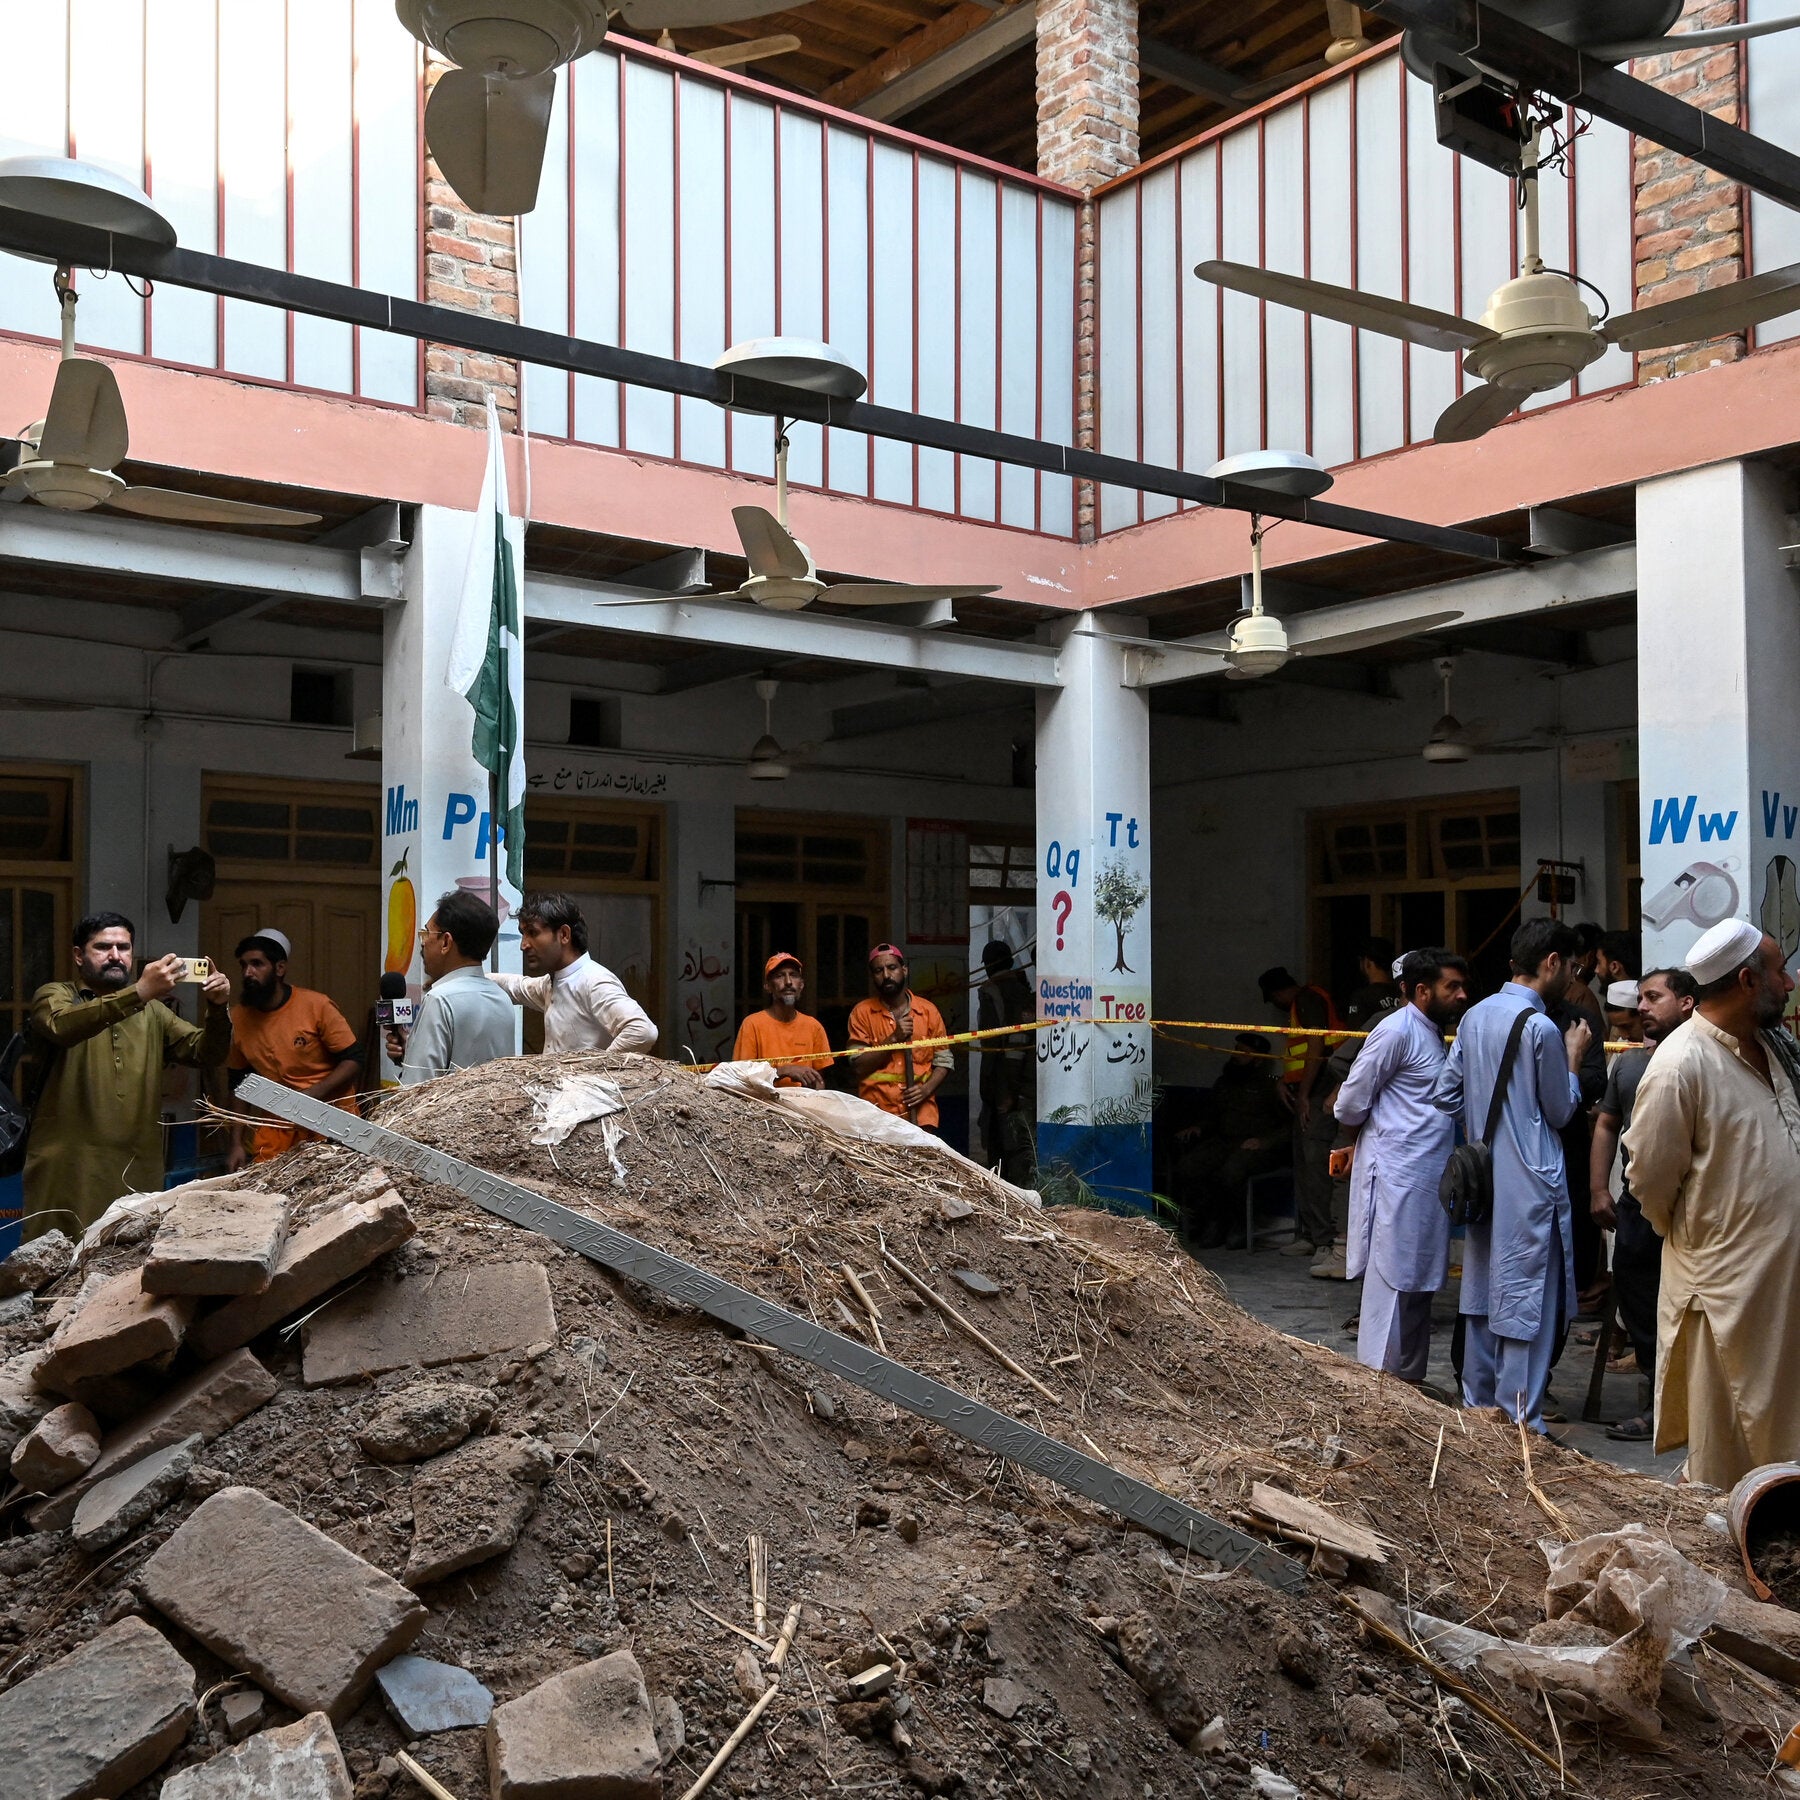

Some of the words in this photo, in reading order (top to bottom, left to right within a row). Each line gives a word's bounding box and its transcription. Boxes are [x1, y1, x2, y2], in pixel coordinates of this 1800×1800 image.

[527, 772, 549, 788] ہے
[554, 768, 572, 790] منع
[386, 785, 418, 836] Mm
[1649, 796, 1738, 844] Ww
[1762, 790, 1798, 839] Vv
[1106, 812, 1139, 848] Tt
[1046, 841, 1080, 887] Qq
[678, 946, 729, 981] سلام
[1040, 979, 1092, 1000] Question
[395, 1006, 411, 1017] 365
[1100, 995, 1146, 1020] Tree
[1107, 1032, 1146, 1065] درخت
